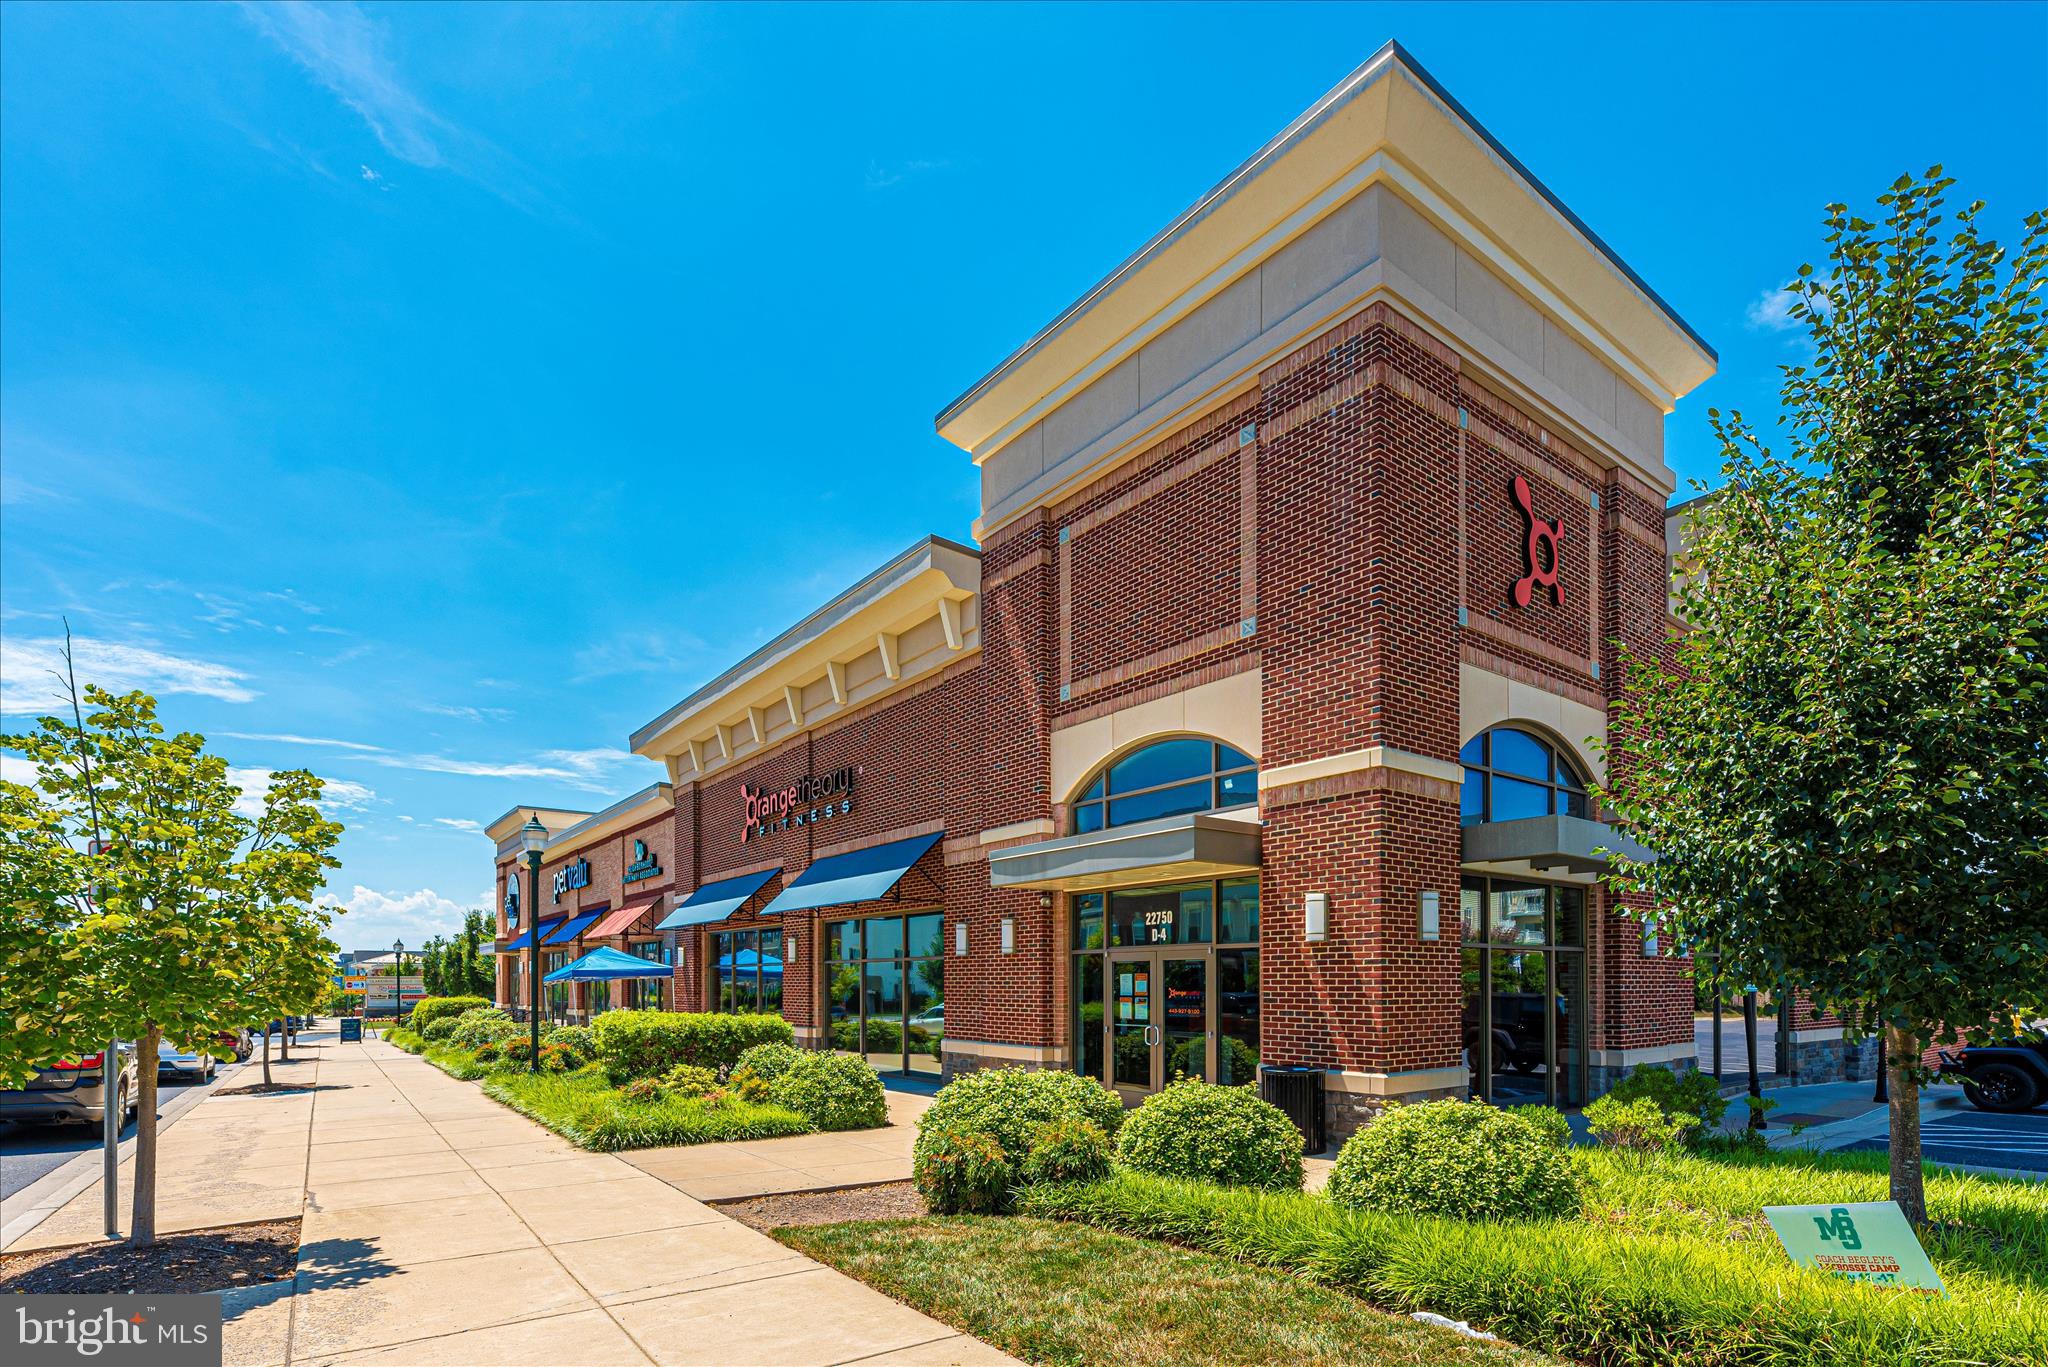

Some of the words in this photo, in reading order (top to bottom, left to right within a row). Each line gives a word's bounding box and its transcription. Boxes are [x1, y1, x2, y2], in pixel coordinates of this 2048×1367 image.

[759, 799, 851, 838] FITNESS
[552, 864, 568, 905] pet
[567, 857, 588, 890] valu
[1145, 910, 1173, 926] 22750
[1151, 927, 1167, 942] D-4
[1815, 1254, 1846, 1264] COACH
[1847, 1255, 1896, 1265] BEGLEY'S
[1868, 1264, 1901, 1273] CAMP
